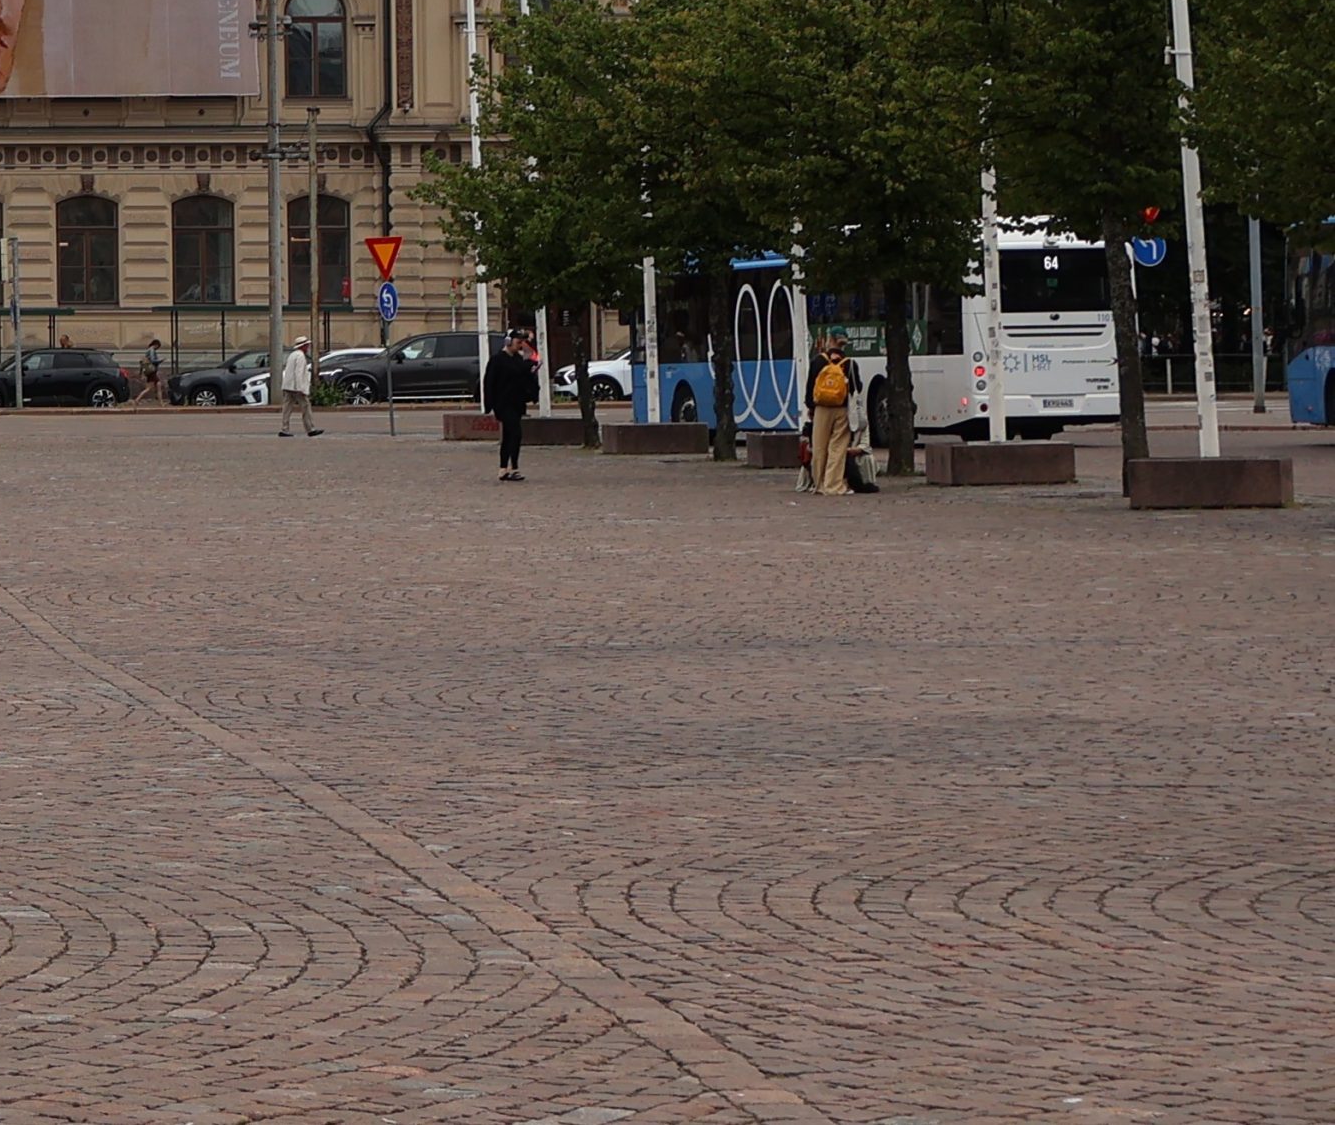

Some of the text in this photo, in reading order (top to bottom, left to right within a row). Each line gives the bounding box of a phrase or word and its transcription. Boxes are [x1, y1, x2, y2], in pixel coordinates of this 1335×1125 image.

[1043, 255, 1059, 271] 64
[1097, 313, 1114, 322] 110
[1032, 354, 1052, 362] HSL
